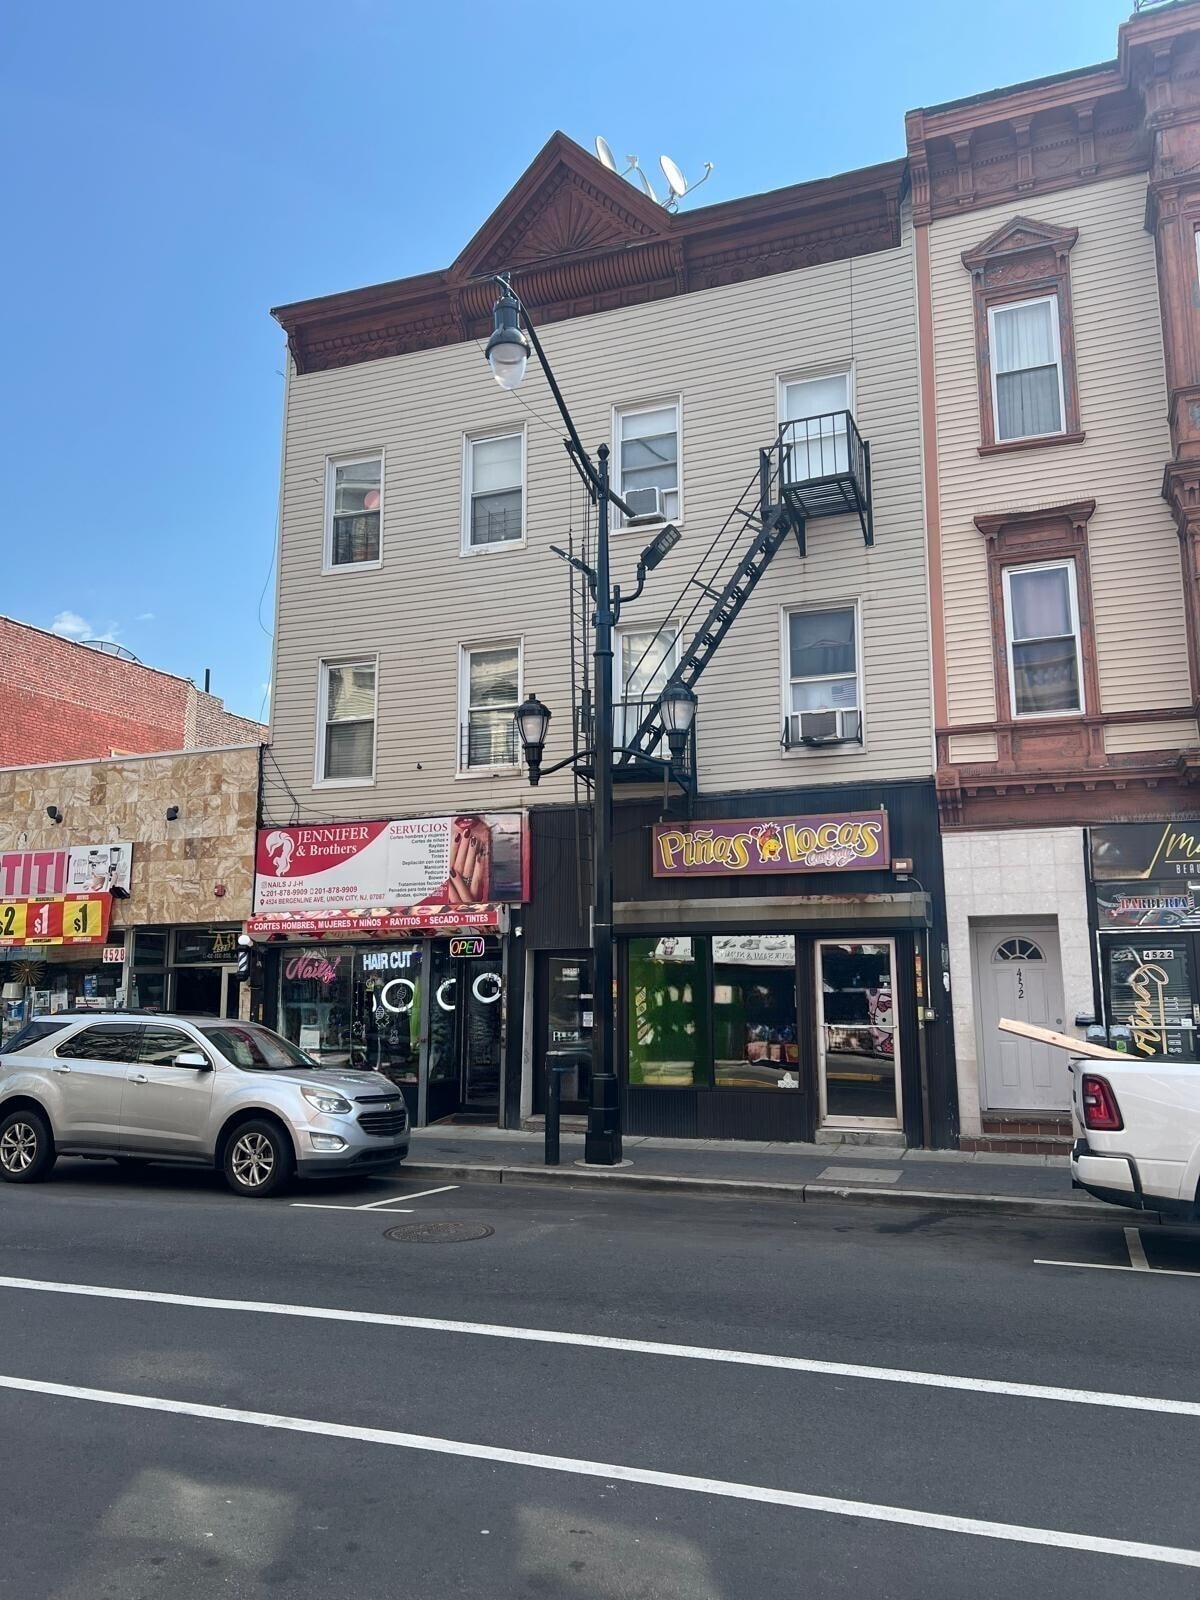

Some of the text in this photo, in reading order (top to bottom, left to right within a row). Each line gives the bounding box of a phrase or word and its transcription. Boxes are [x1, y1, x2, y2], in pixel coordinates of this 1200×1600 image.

[297, 827, 369, 845] JENNIFER
[390, 823, 448, 834] SERVICIOS
[296, 843, 357, 856] & Brothers
[659, 828, 752, 869] Piñas
[783, 822, 881, 862] Locas
[266, 886, 358, 897] 201-878-9909 201-878-9909
[34, 903, 50, 935] $1
[73, 903, 88, 934] $1
[253, 914, 488, 931] CORTES HOMBRES, MUJERES Y NIÑOS RAYITOS SECADO TINTES
[103, 948, 125, 961] 4528
[451, 940, 483, 954] OPEN
[363, 951, 412, 970] HAIR CUT
[1144, 951, 1173, 959] 4522
